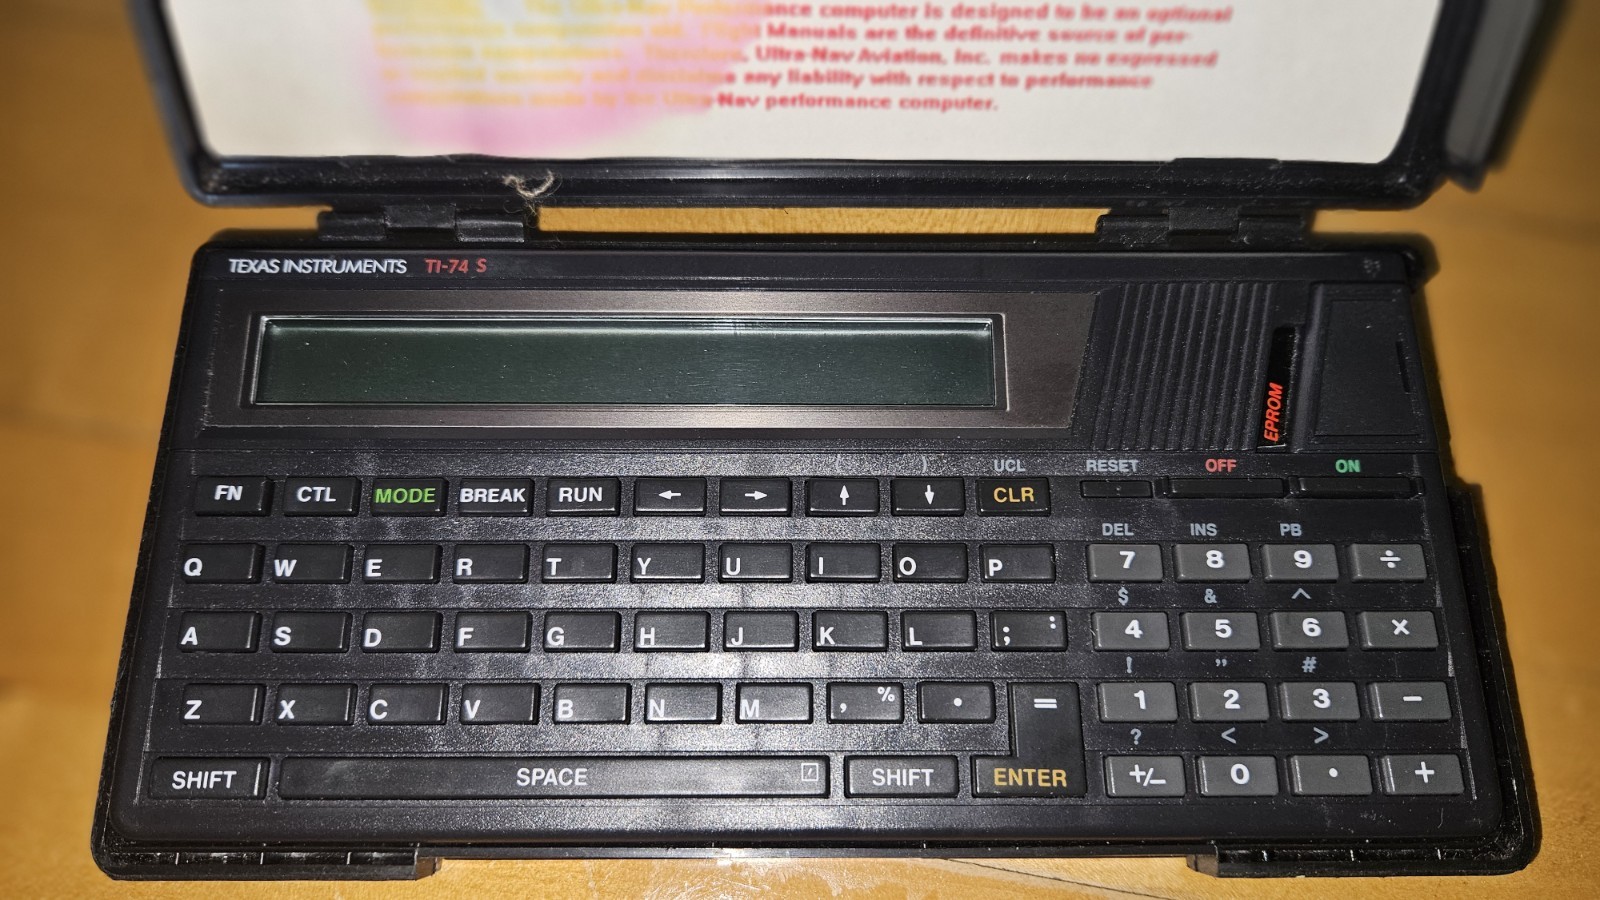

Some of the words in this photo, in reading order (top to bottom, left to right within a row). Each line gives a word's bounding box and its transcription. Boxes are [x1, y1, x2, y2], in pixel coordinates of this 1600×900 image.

[818, 3, 921, 22] computer
[923, 3, 944, 20] is
[950, 3, 1050, 24] designed
[1053, 3, 1077, 21] to
[1080, 4, 1109, 21] be
[1113, 6, 1141, 22] an
[1146, 5, 1234, 24] optional
[766, 24, 858, 41] Manuals
[864, 25, 899, 41] are
[905, 24, 938, 41] the
[943, 24, 1042, 42] definitive
[1047, 26, 1118, 43] source
[1123, 26, 1147, 43] of
[954, 48, 990, 65] Inc.
[999, 49, 1070, 66] makes
[1074, 51, 1103, 66] no
[744, 70, 783, 88] any
[787, 68, 864, 88] liability
[869, 70, 913, 87] with
[918, 71, 996, 90] respect
[999, 72, 1022, 88] to
[1025, 72, 1153, 91] performance
[766, 91, 892, 110] performance
[899, 94, 999, 113] computer.
[229, 259, 280, 273] TEXAS
[283, 259, 406, 273] INSTRUMENTS
[426, 259, 468, 273] TI-74
[477, 259, 486, 272] S
[1264, 383, 1282, 441] EPROM
[994, 459, 1025, 472] UCL
[1086, 460, 1139, 472] RESET
[1206, 459, 1236, 472] OFF
[1336, 460, 1360, 473] ON
[215, 485, 242, 500] FN
[297, 487, 336, 502] CTL
[376, 488, 435, 503] MODE
[460, 488, 525, 502] BREAK
[559, 487, 602, 502] RUN
[994, 487, 1034, 502] CLR
[1102, 523, 1134, 535] DEL
[1191, 523, 1217, 536] INS
[1280, 524, 1301, 536] PB
[184, 558, 202, 576] Q
[275, 560, 297, 576] W
[367, 559, 382, 577] E
[457, 559, 472, 575] R
[547, 558, 561, 575] T
[638, 558, 651, 575] Y
[726, 558, 740, 575] U
[900, 557, 916, 575] O
[989, 559, 1002, 576] P
[1120, 551, 1135, 568] 7
[1206, 550, 1224, 568] 8
[1294, 550, 1312, 568] 9
[1118, 587, 1128, 605] $
[1205, 589, 1217, 603] &
[181, 627, 197, 645] A
[274, 627, 291, 645] S
[909, 627, 922, 645] L
[1125, 620, 1142, 638] 4
[1216, 620, 1231, 638] 5
[1303, 618, 1321, 636] 6
[365, 629, 381, 647] D
[458, 628, 473, 646] F
[547, 627, 564, 647] G
[639, 628, 657, 646] H
[730, 627, 745, 646] J
[817, 627, 835, 646] K
[878, 687, 895, 701] %
[1134, 690, 1145, 709] 1
[1224, 690, 1240, 709] 2
[1313, 689, 1330, 708] 3
[184, 700, 202, 719] Z
[279, 700, 295, 719] X
[370, 700, 387, 719] C
[465, 700, 480, 719] V
[558, 700, 573, 720] B
[649, 699, 666, 718] N
[740, 700, 762, 719] M
[1131, 729, 1141, 745] ?
[172, 771, 236, 789] SHIFT
[517, 768, 587, 786] SPACE
[873, 768, 933, 786] SHIFT
[994, 768, 1066, 786] ENTER
[1231, 764, 1249, 784] 0
